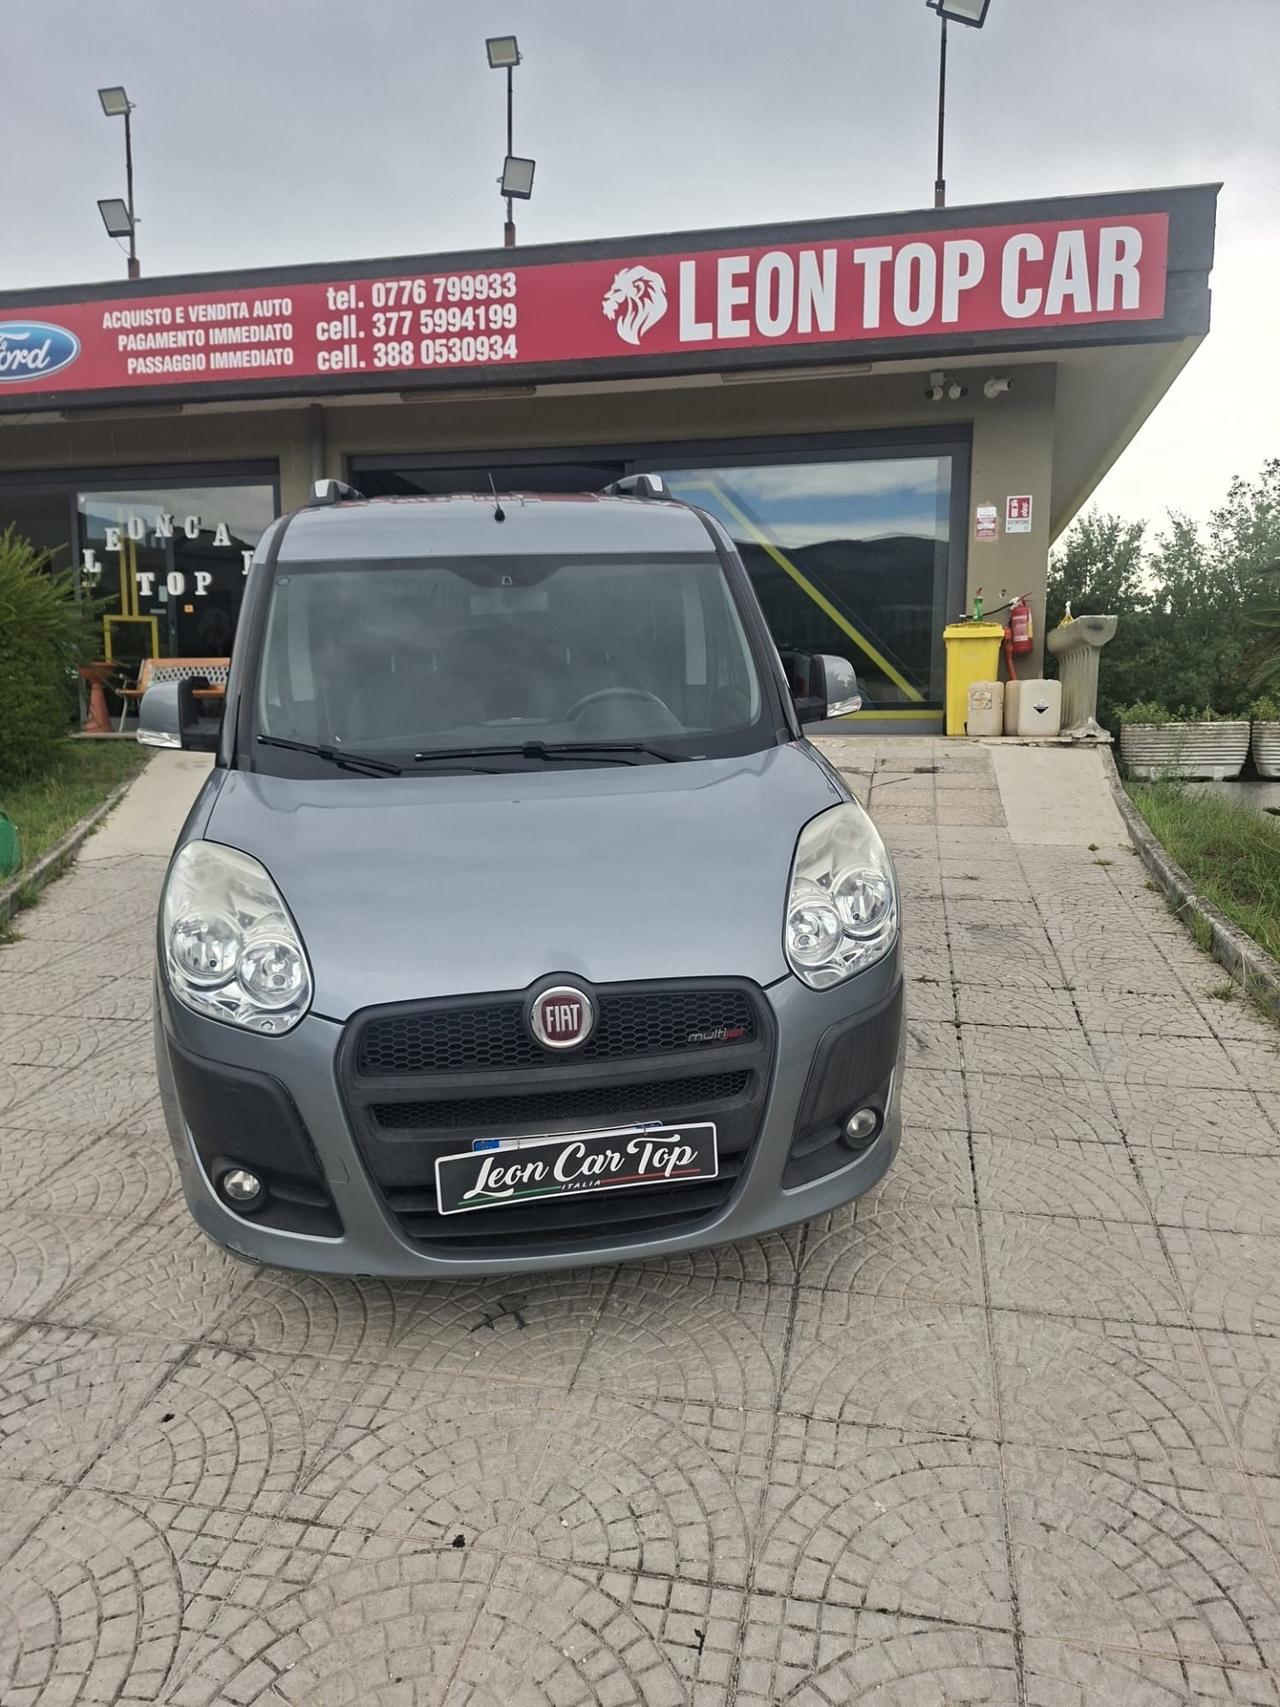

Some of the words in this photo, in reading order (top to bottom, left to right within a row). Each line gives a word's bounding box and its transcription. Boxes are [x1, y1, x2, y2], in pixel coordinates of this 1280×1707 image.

[326, 284, 365, 311] tel.
[371, 279, 427, 308] 0776
[433, 272, 517, 302] 799933
[679, 248, 838, 342] LEON
[853, 239, 985, 329] TOP
[1001, 226, 1143, 319] CAR
[103, 307, 172, 329] ACQUISTO
[175, 306, 185, 323] E
[188, 302, 249, 322] VENDITA
[253, 298, 292, 318] AUTO
[316, 314, 365, 341] cell.
[372, 311, 413, 337] 377
[420, 303, 518, 334] 5994199
[118, 329, 205, 351] PAGAMENTO
[209, 323, 293, 345] IMMEDIATO
[317, 345, 366, 371] cell.
[373, 340, 414, 367] 388
[421, 334, 518, 364] 0530934
[127, 353, 206, 374] PASSAGGIO
[210, 348, 294, 369] IMMEDIATO
[136, 571, 213, 596] TOP
[545, 1004, 580, 1032] FIAT
[463, 1157, 549, 1199] Leon
[553, 1142, 625, 1182] Car
[627, 1134, 699, 1177] Top
[560, 1179, 602, 1191] ITALIA
